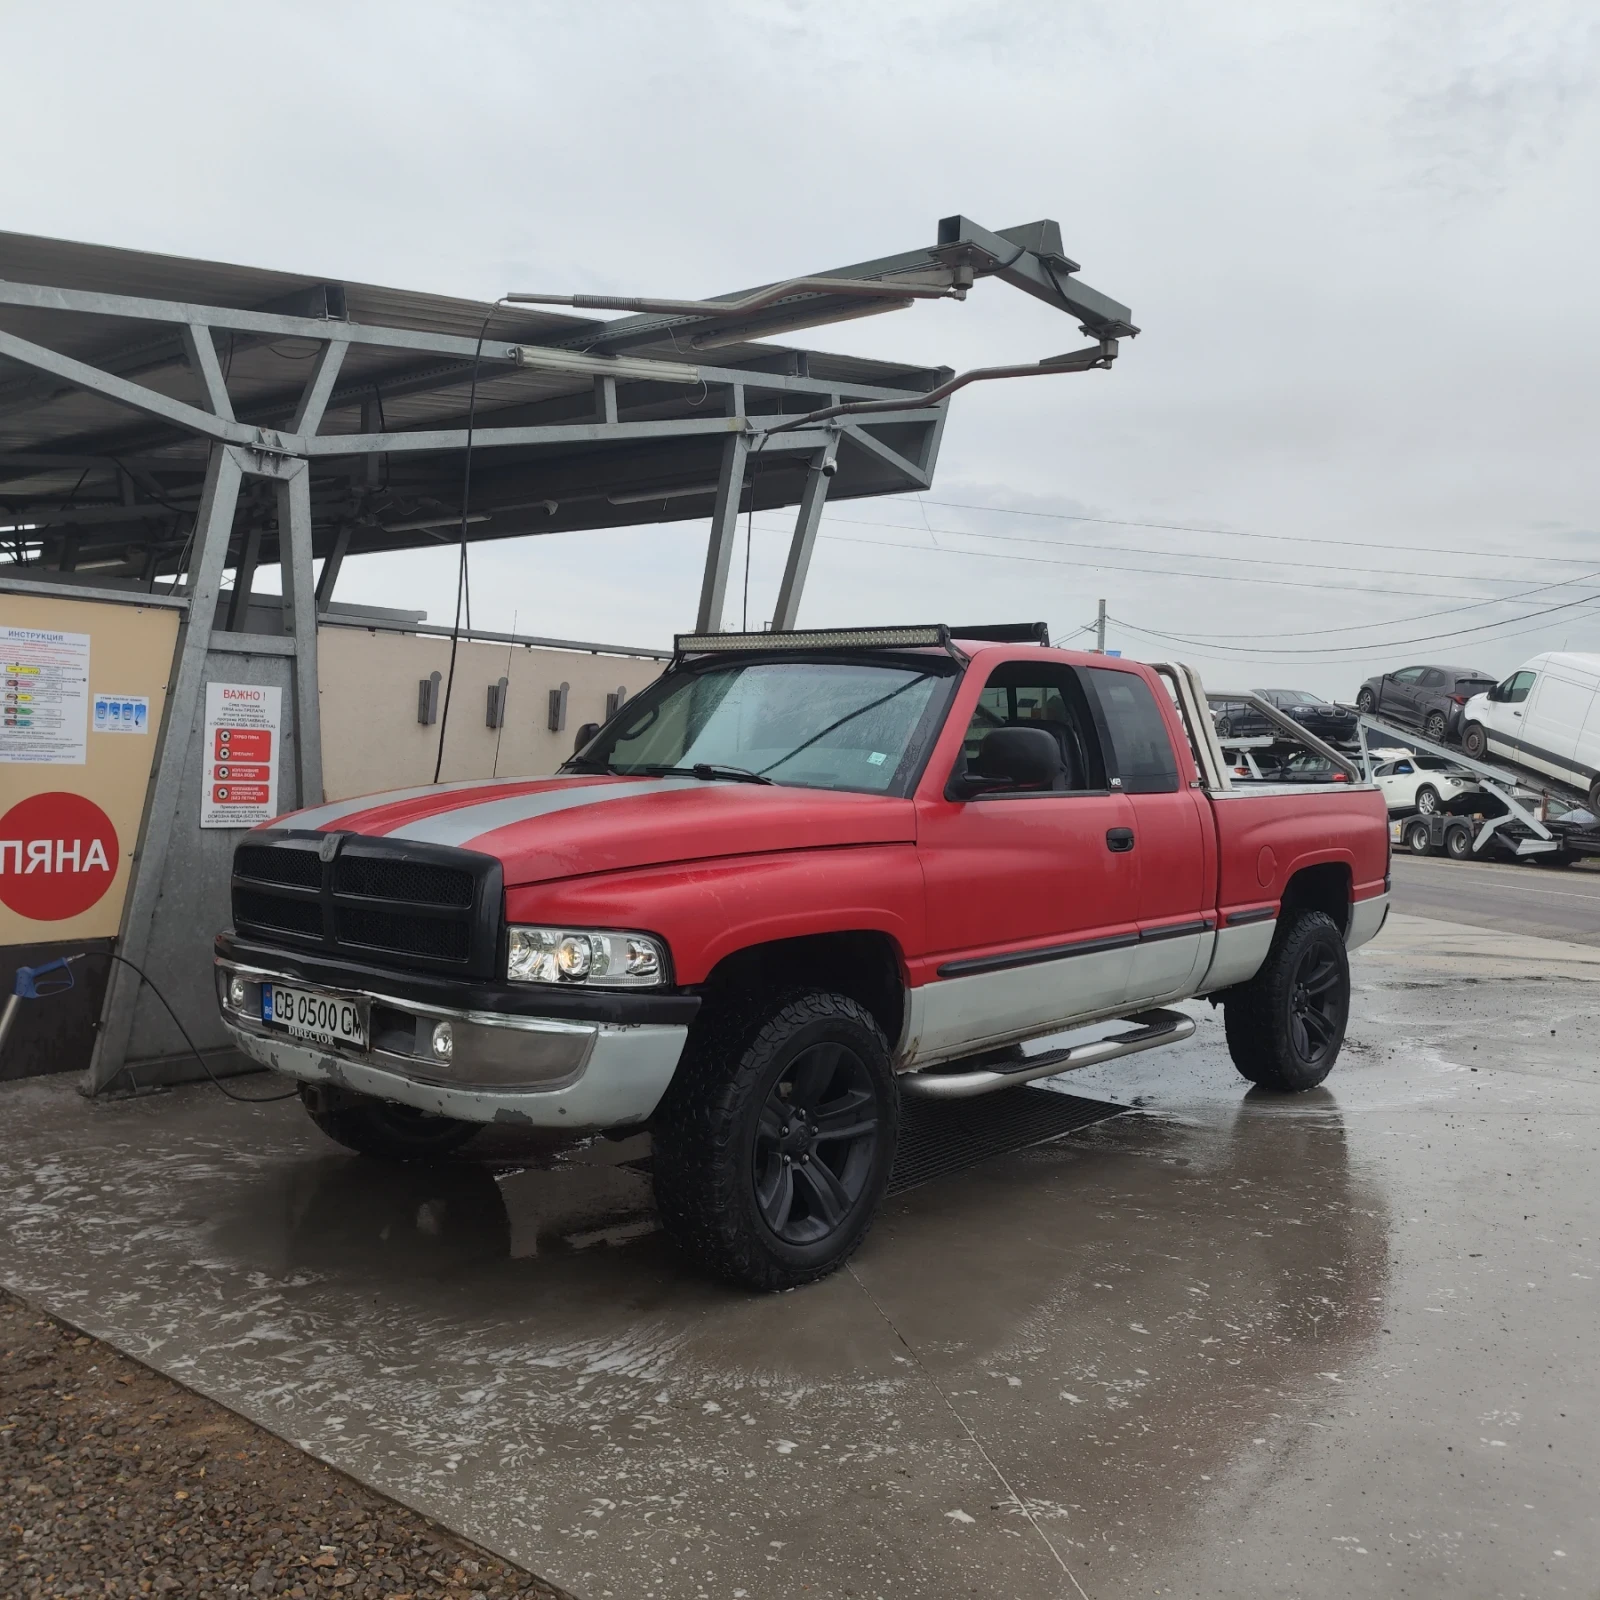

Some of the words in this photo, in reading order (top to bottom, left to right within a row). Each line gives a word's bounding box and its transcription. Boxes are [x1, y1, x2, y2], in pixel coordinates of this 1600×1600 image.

[8, 630, 64, 641] ИНСТРУКЦИЯ
[223, 689, 260, 701] ВАЖНО
[0, 839, 110, 874] ПЯНА
[264, 1006, 272, 1014] BG
[275, 990, 294, 1020] CB
[298, 996, 337, 1032] 0500
[288, 1025, 335, 1046] DIRECTOR
